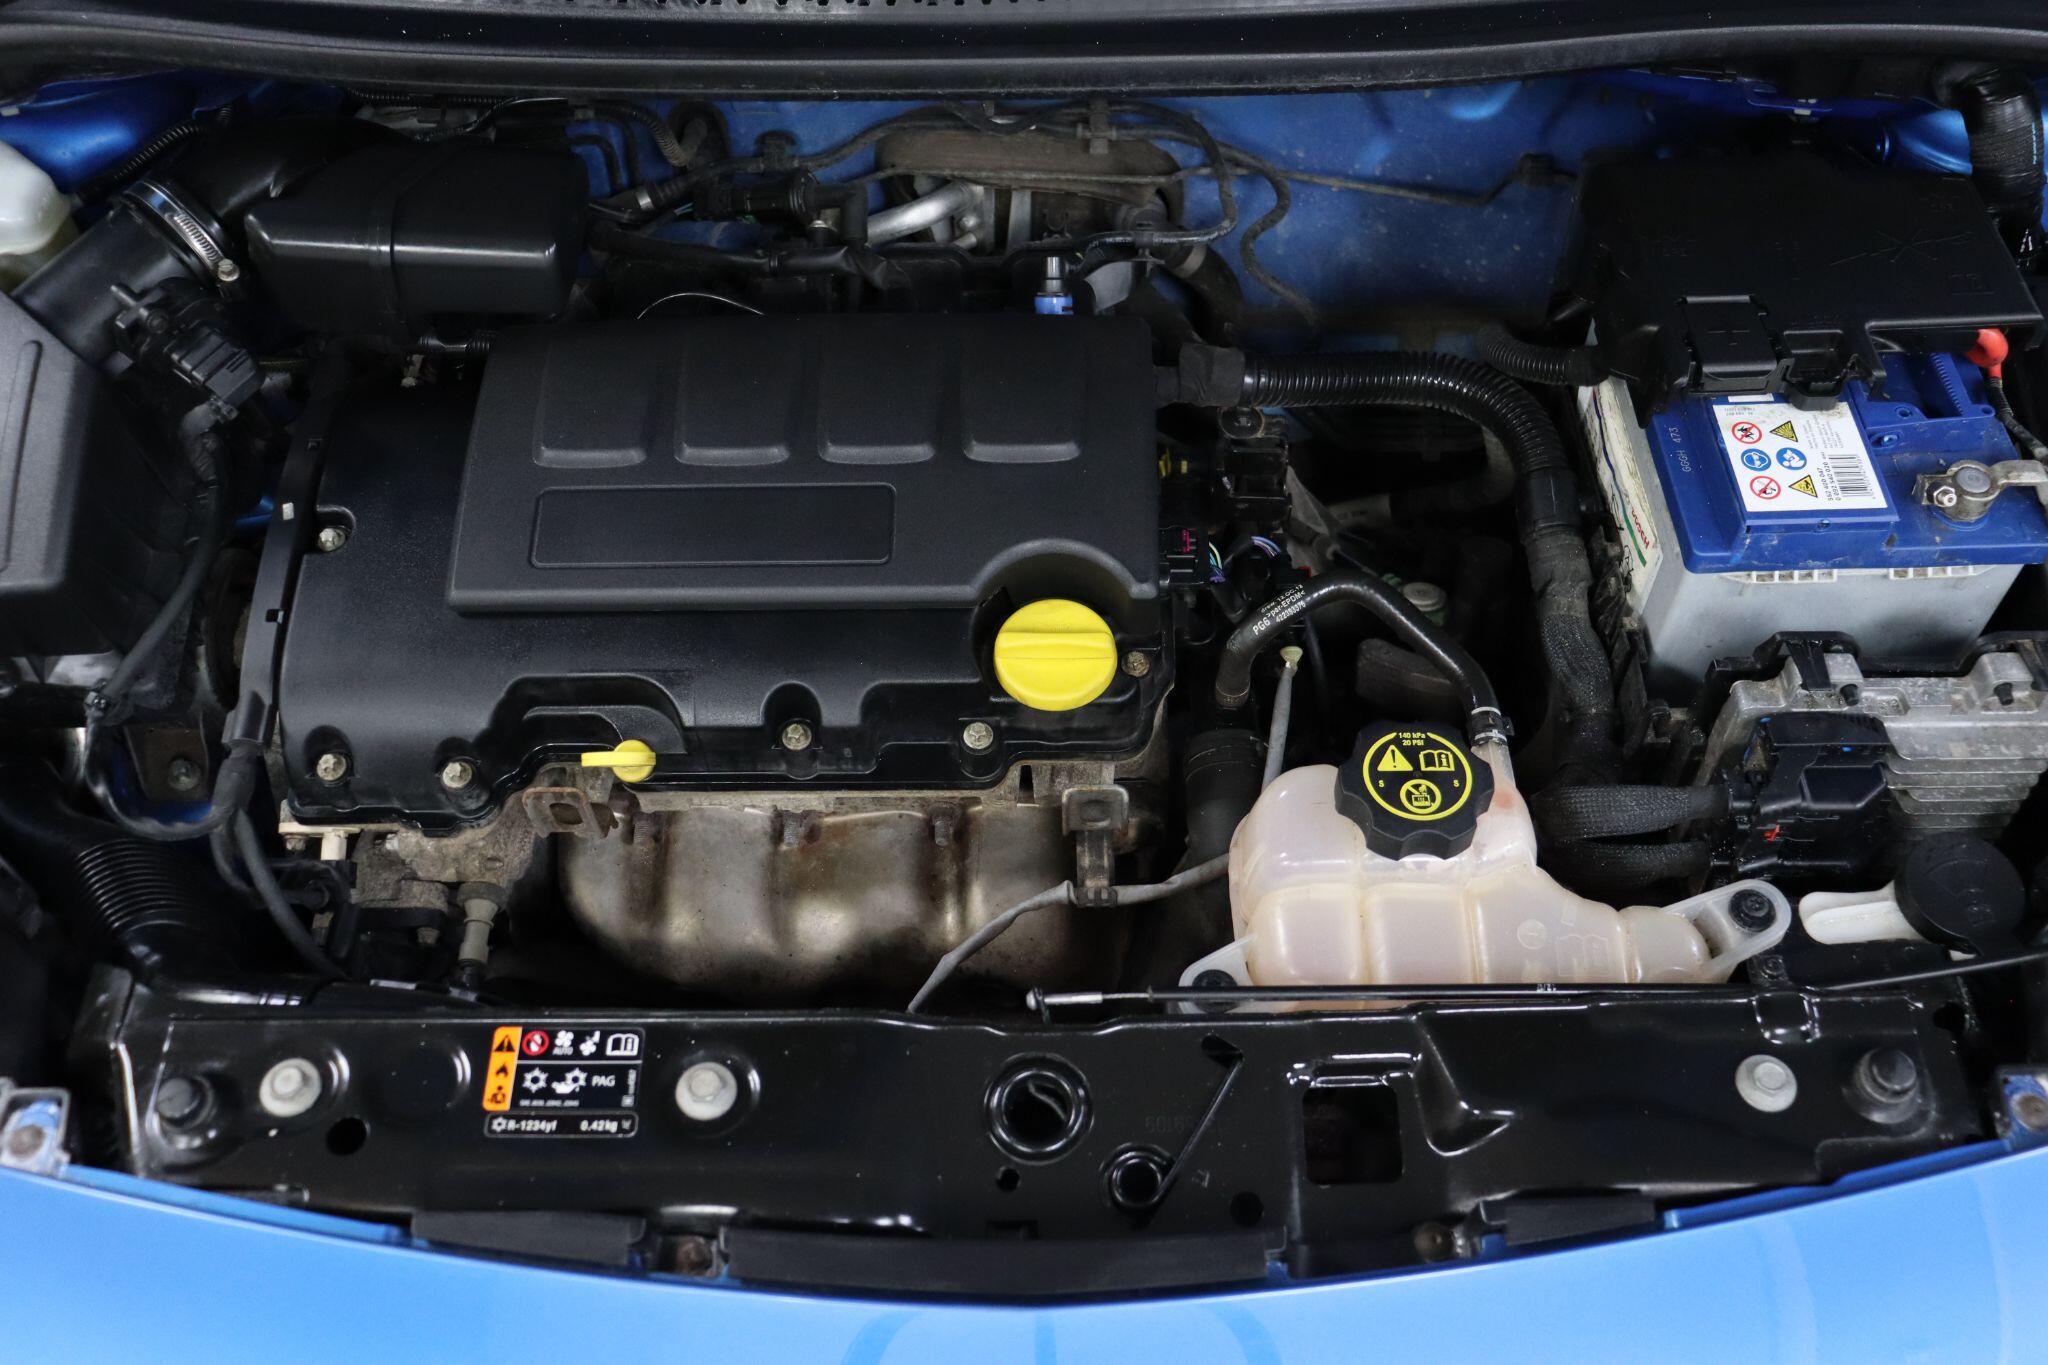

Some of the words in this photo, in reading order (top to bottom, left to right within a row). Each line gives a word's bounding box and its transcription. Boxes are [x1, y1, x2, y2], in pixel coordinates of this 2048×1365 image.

[1252, 617, 1271, 636] PG6
[1378, 780, 1385, 788] S
[1453, 780, 1460, 788] S
[552, 1046, 574, 1056] AUTO
[591, 1075, 616, 1087] PAG
[507, 1119, 557, 1133] R-1234yf
[580, 1118, 619, 1134] 0.42kg
